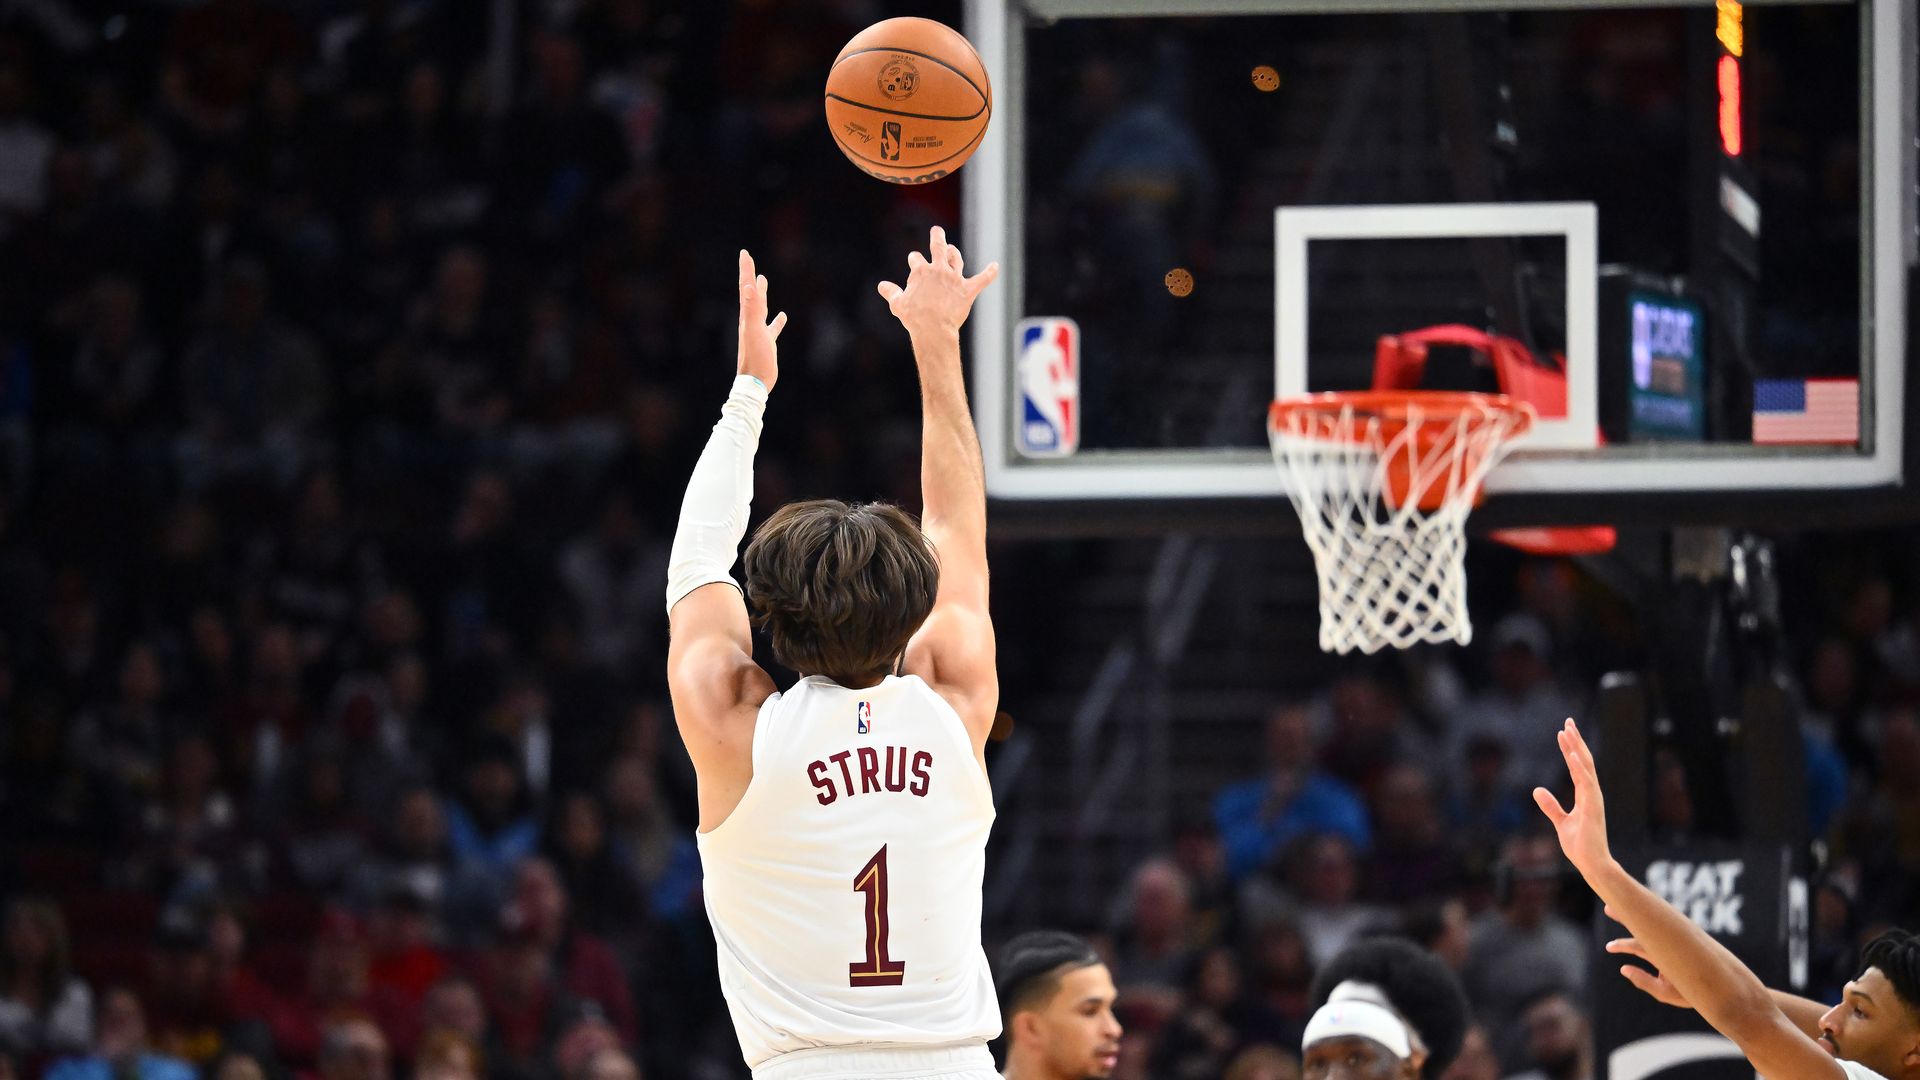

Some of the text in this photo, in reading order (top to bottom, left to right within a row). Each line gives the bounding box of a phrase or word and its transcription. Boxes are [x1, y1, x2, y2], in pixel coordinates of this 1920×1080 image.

[807, 746, 933, 806] STRUS
[1646, 860, 1744, 899] SEAT
[849, 843, 905, 987] 1
